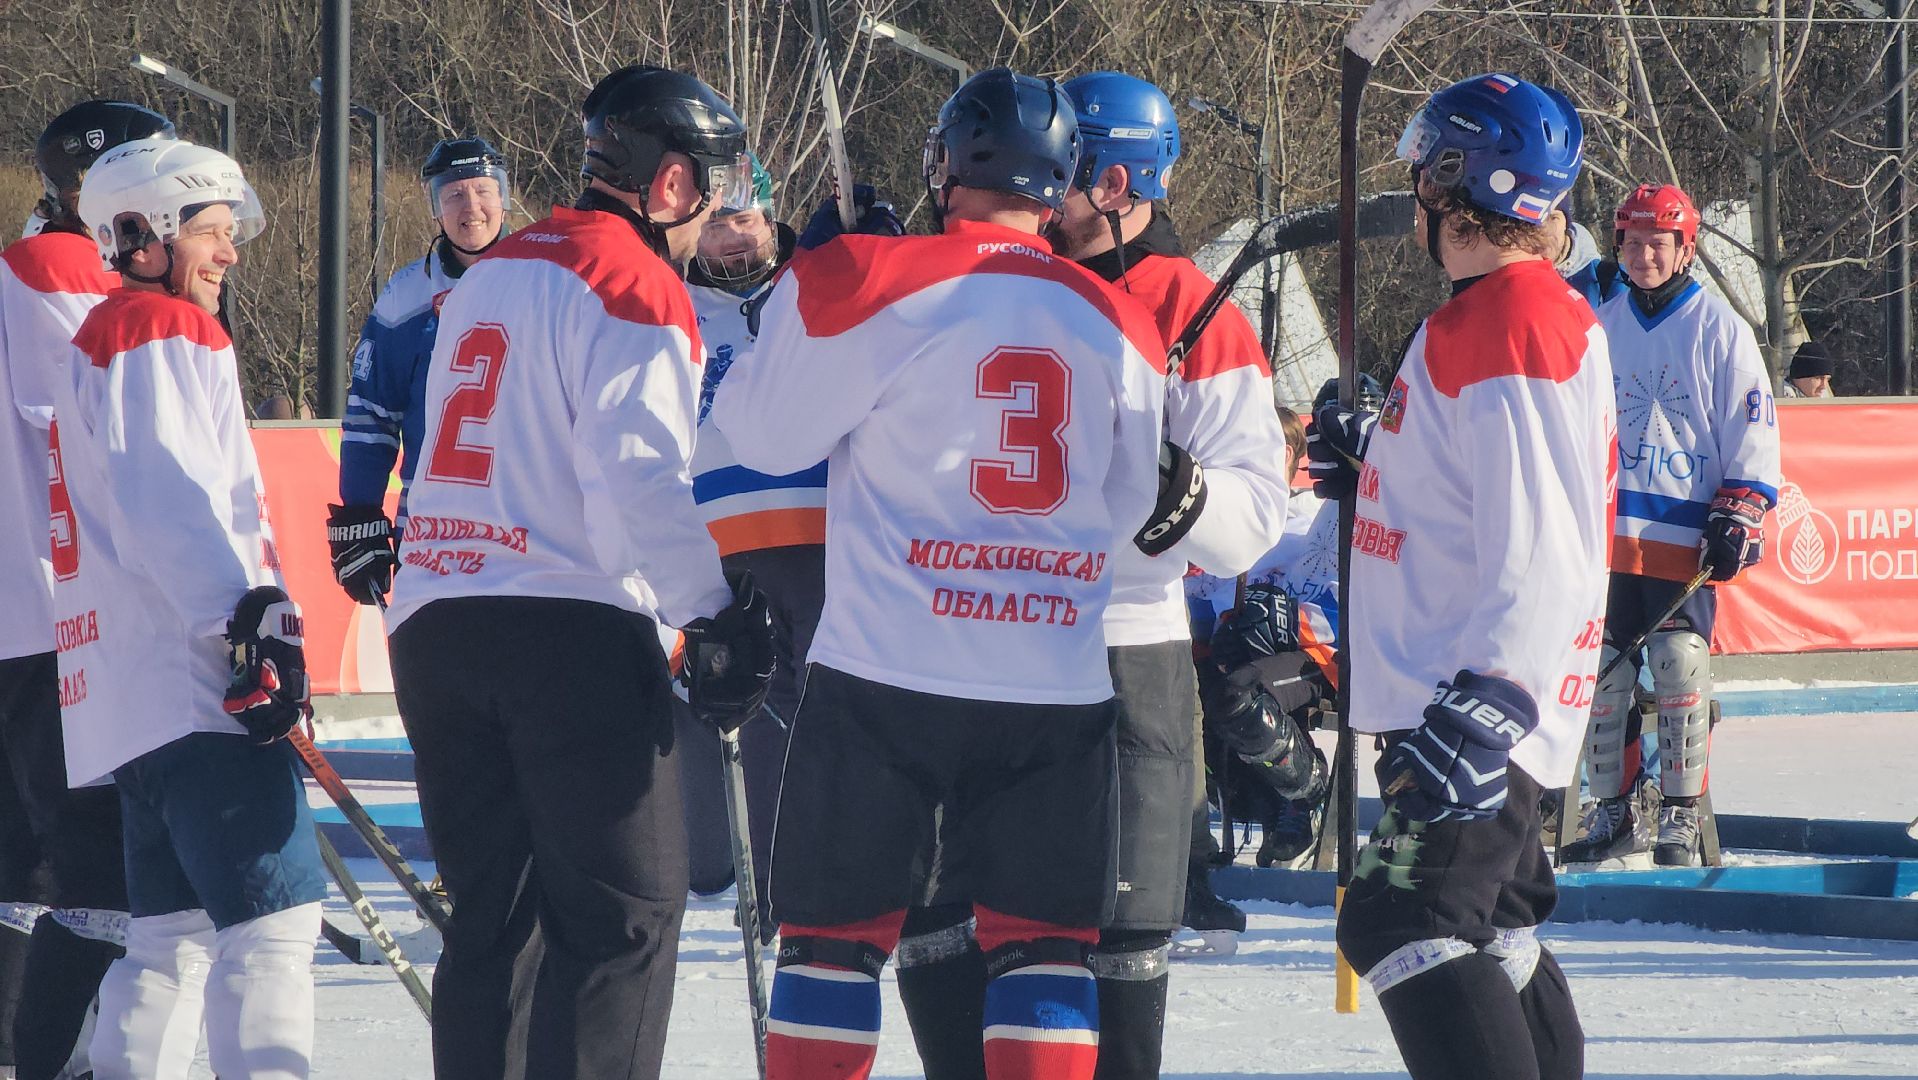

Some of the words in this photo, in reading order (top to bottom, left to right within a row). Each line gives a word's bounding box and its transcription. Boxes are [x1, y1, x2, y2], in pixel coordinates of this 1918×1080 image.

[1449, 114, 1482, 134] BAUER
[1631, 210, 1656, 218] Reebok
[977, 243, 1053, 264] РУСФЛАГ
[425, 321, 510, 488] 2
[1744, 387, 1774, 427] 80
[969, 345, 1072, 516] 3
[1847, 550, 1918, 581] ПОД
[932, 587, 1078, 627] ОБЛАСТЬ
